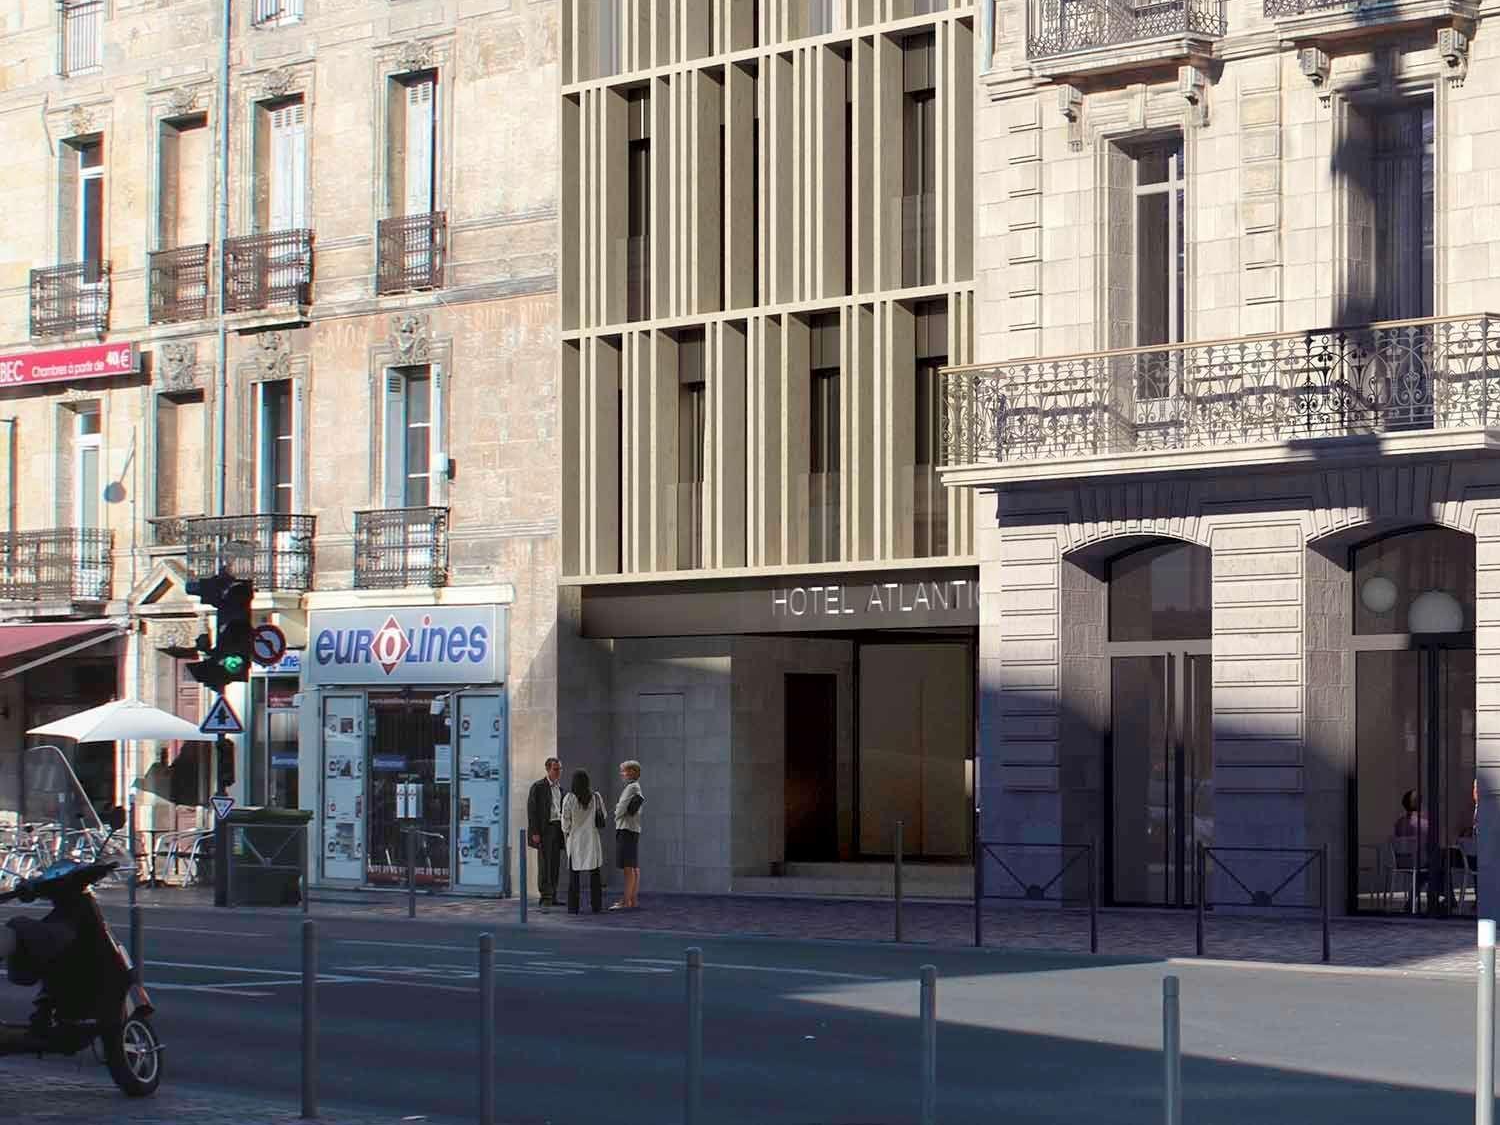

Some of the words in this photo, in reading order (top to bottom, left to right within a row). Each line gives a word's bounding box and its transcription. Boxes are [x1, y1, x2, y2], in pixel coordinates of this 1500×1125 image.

[32, 365, 67, 377] Chambres
[75, 361, 93, 375] partir
[95, 360, 104, 371] de
[771, 585, 854, 616] HOTEL
